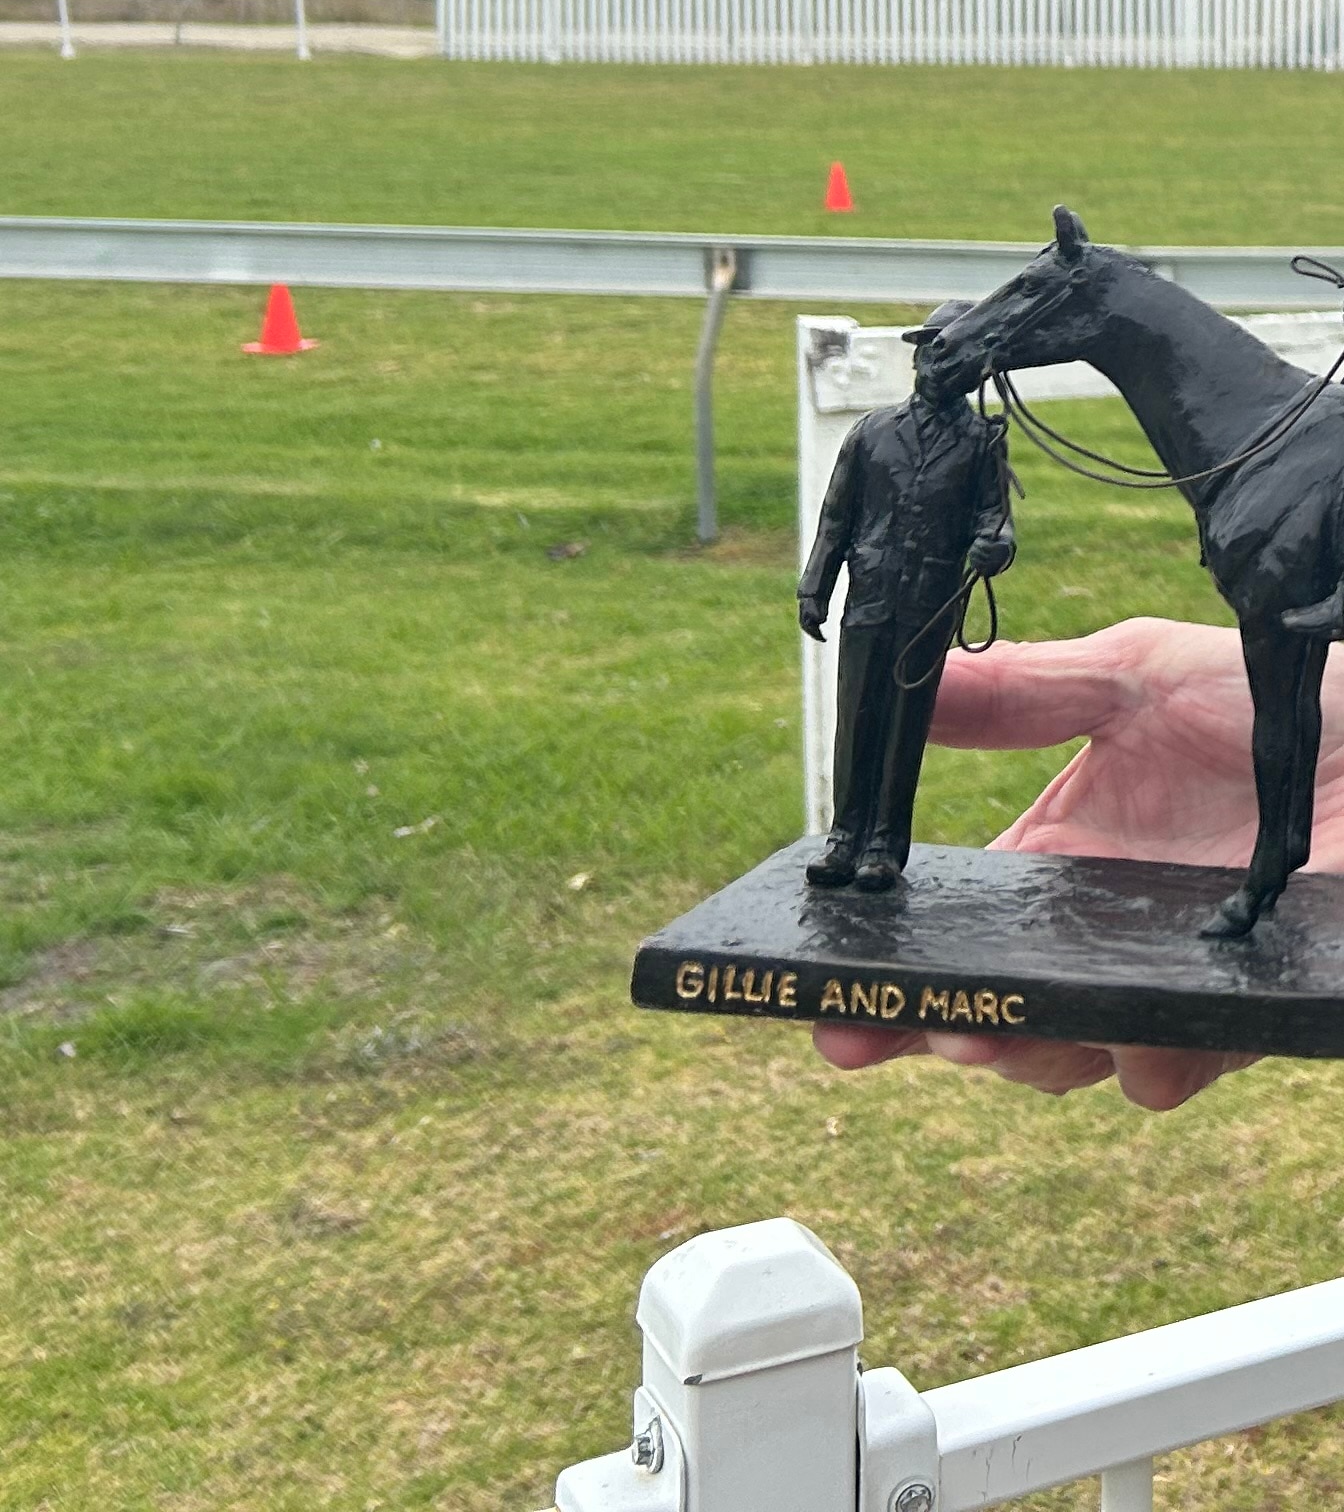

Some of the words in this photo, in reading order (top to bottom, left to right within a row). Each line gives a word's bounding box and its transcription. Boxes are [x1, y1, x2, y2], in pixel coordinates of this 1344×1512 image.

[675, 960, 798, 1006] GILLIE
[819, 978, 906, 1020] AND
[917, 984, 1026, 1026] MARC
